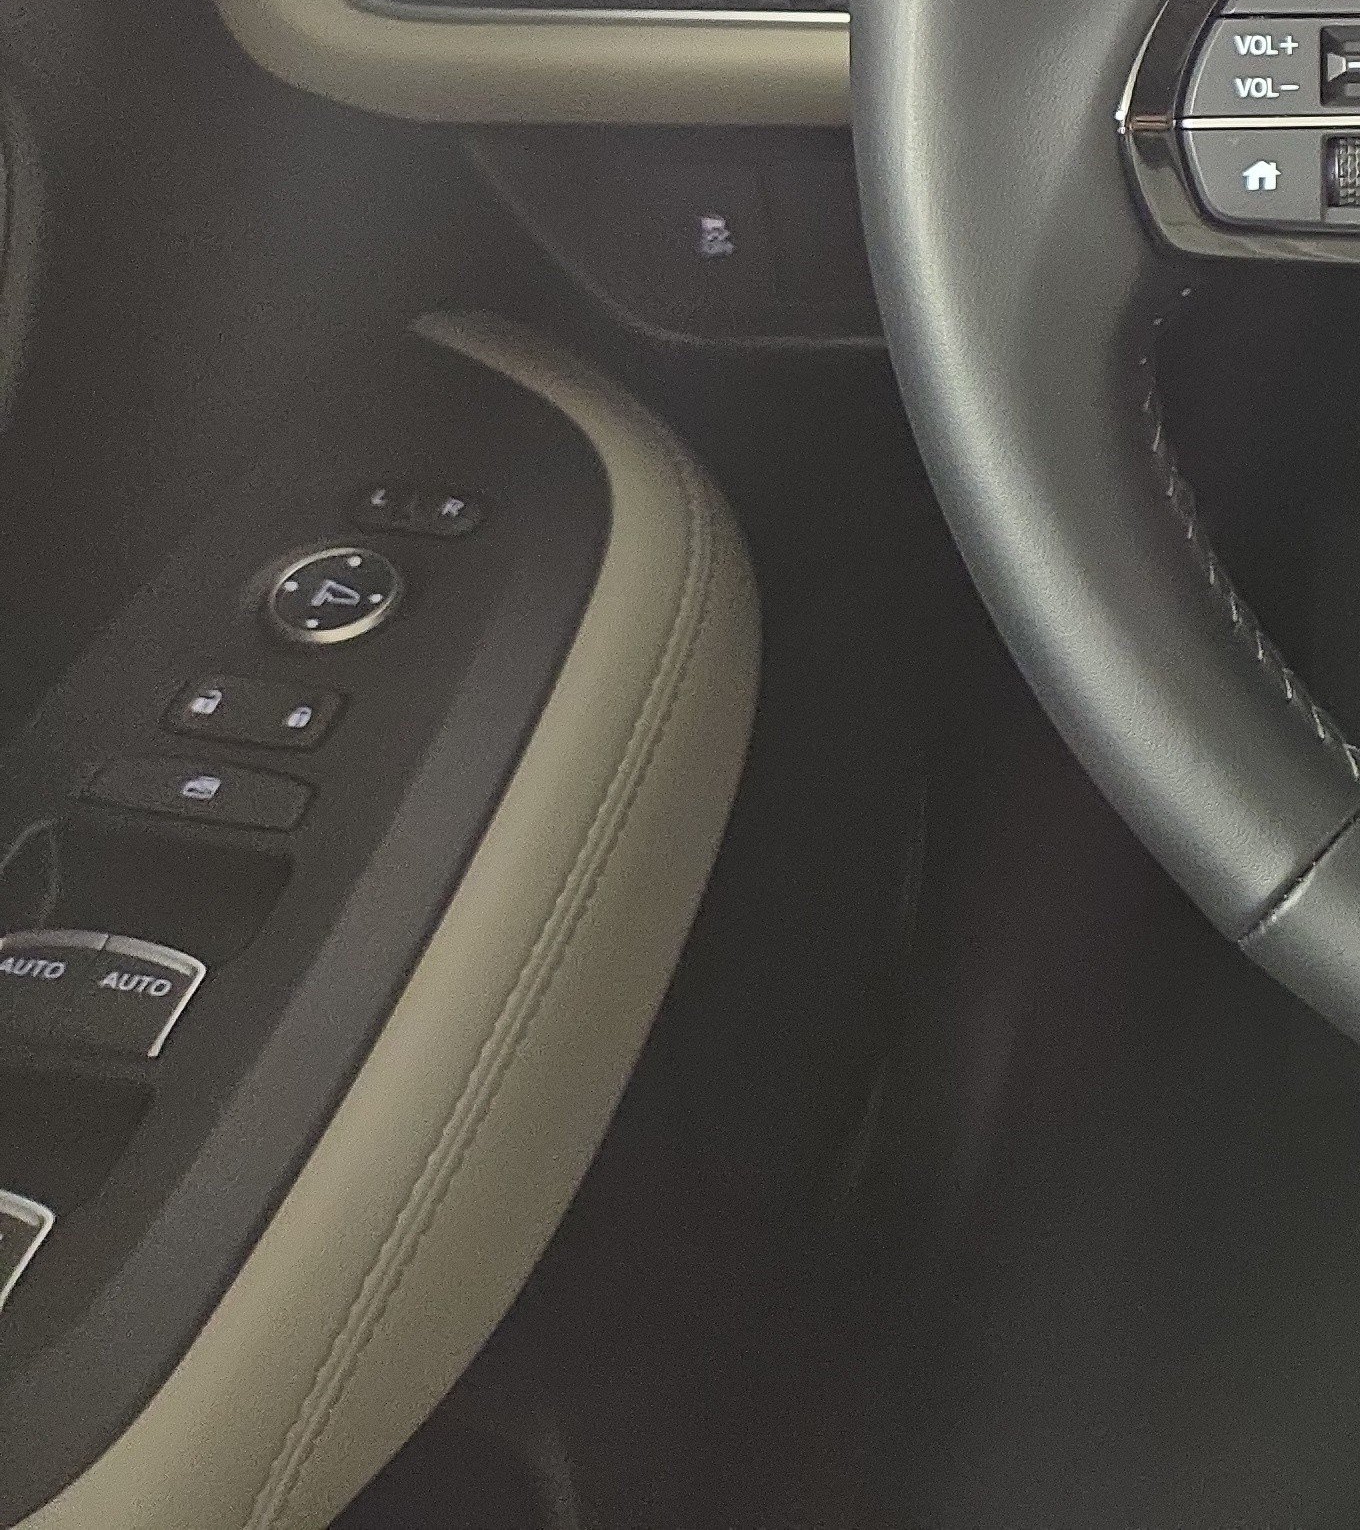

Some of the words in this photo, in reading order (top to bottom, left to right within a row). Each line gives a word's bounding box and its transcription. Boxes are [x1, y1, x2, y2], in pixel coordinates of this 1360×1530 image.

[1234, 35, 1299, 56] VOL+
[0, 957, 66, 979] AUTO
[100, 971, 173, 997] AUTO
